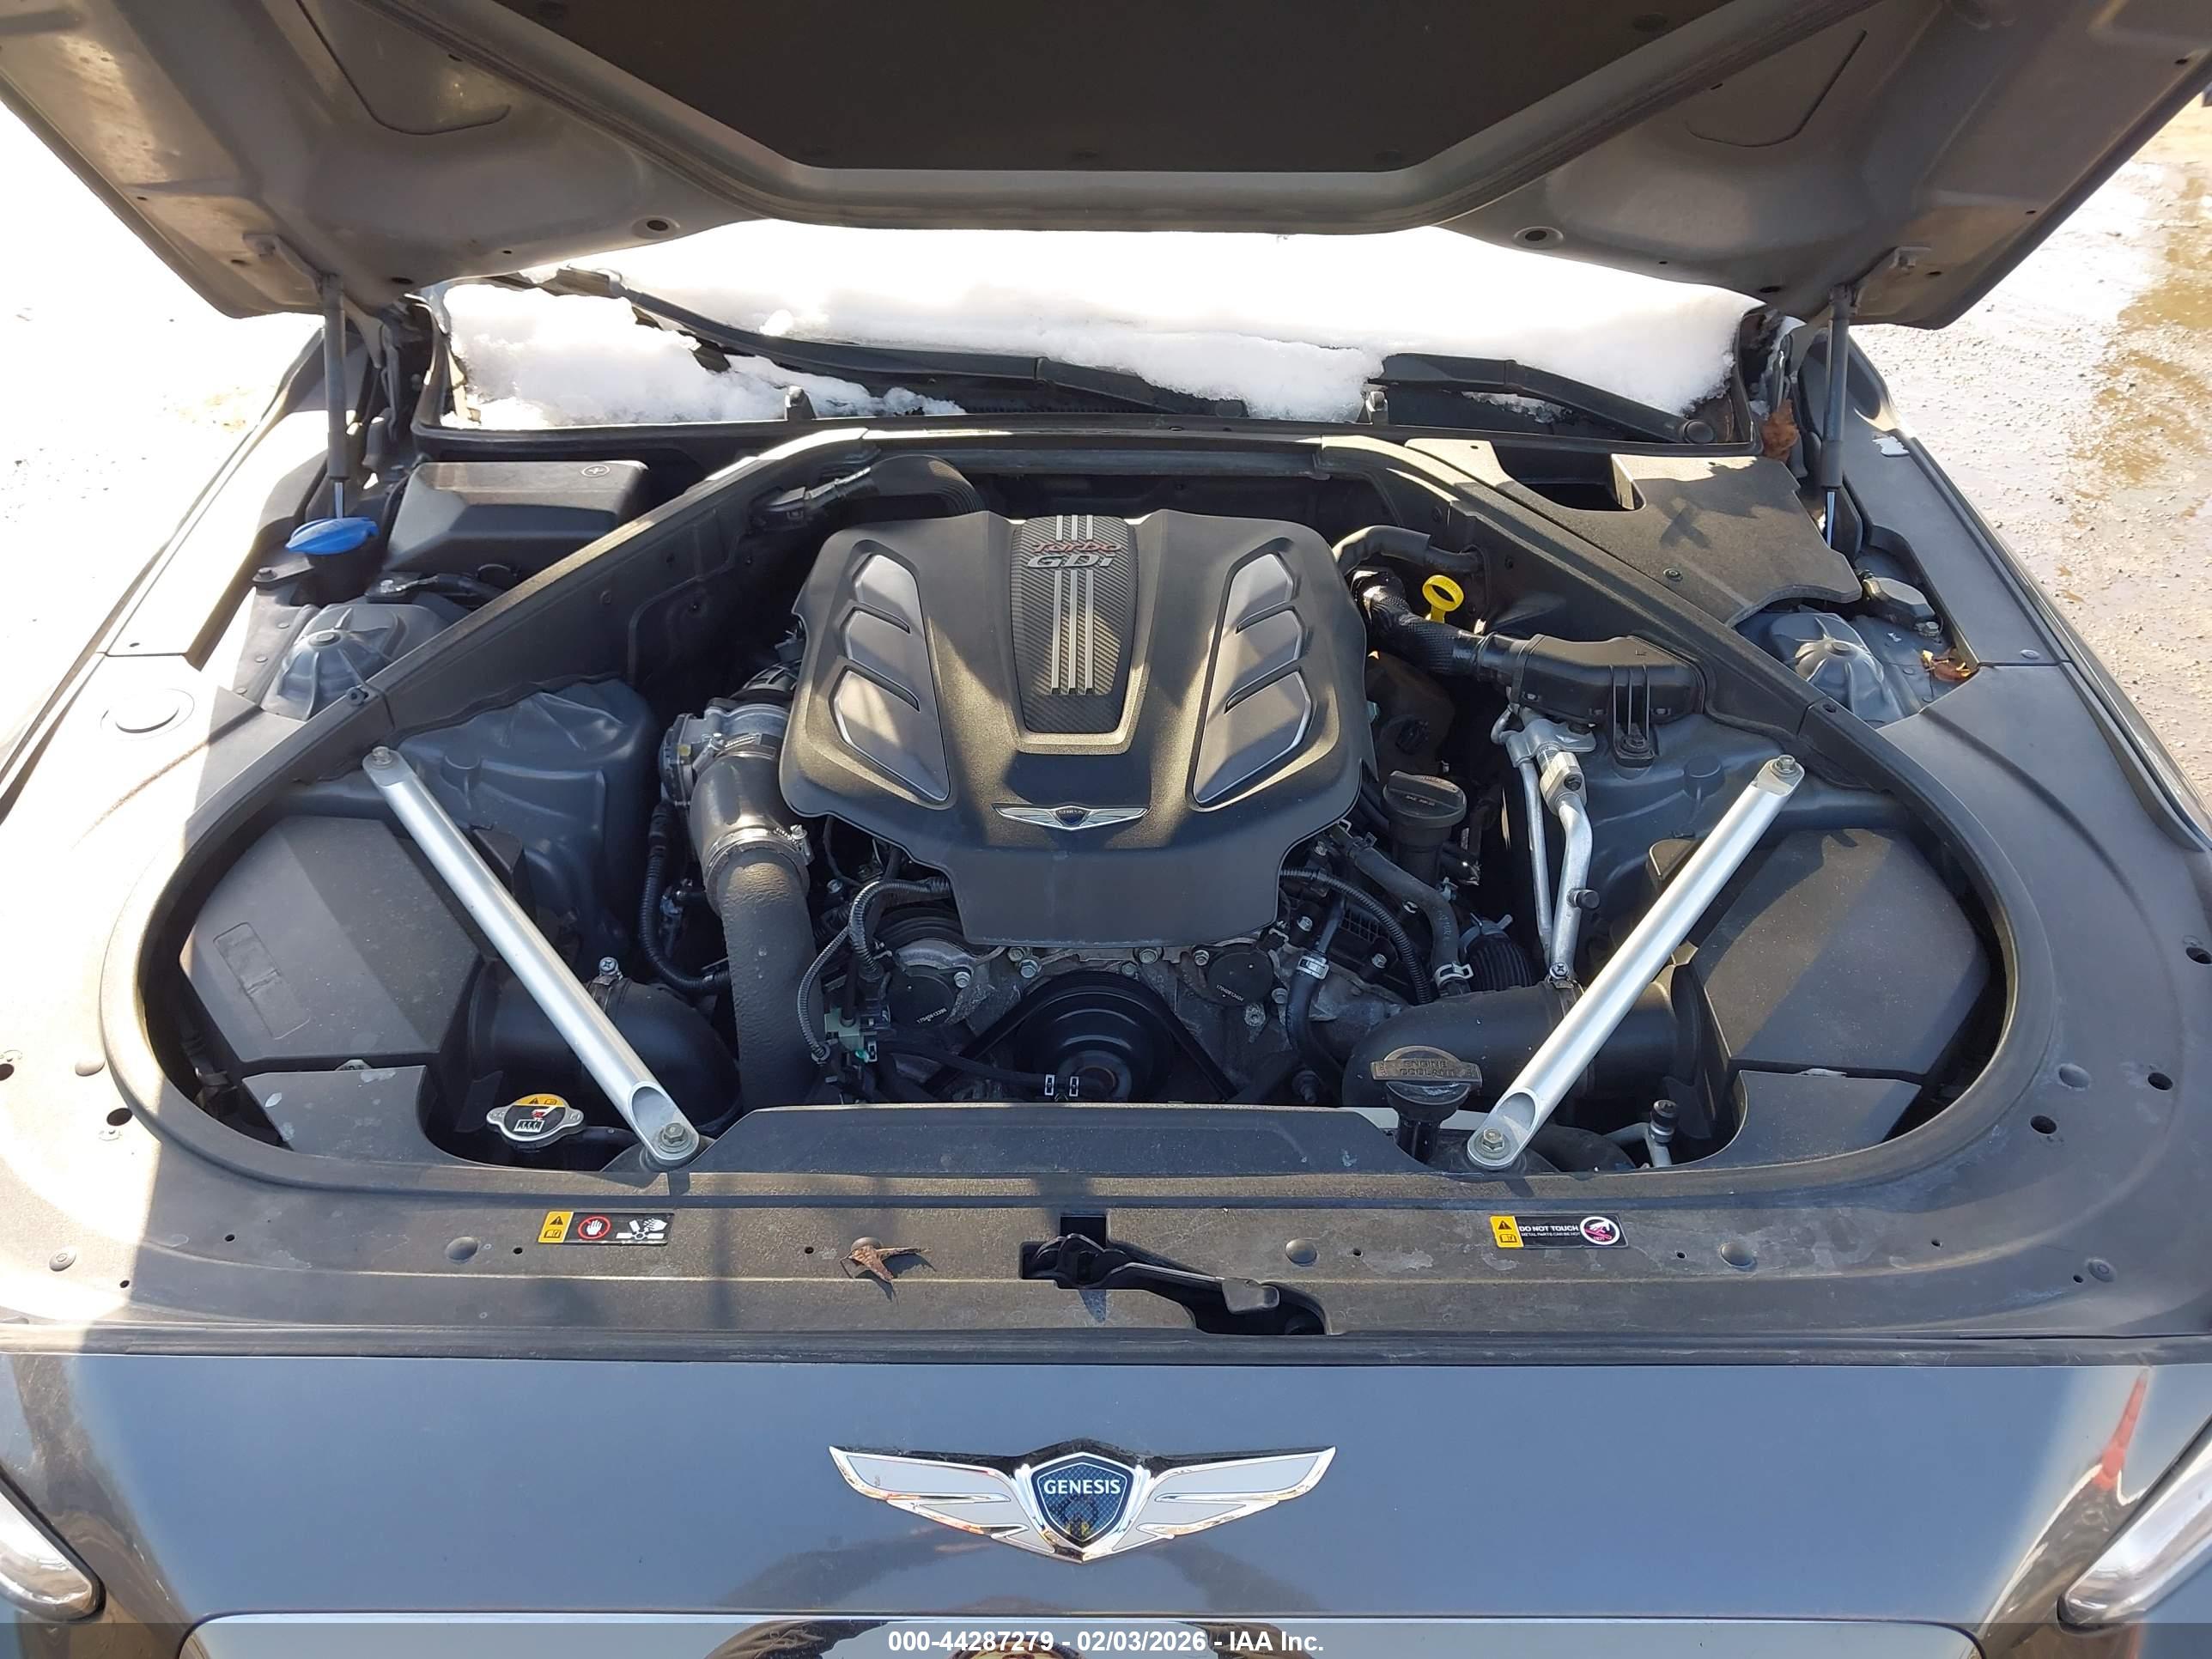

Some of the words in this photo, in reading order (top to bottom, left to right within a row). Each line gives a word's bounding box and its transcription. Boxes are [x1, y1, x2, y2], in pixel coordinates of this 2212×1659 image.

[1403, 1059, 1447, 1068] ENGINE
[1400, 1068, 1454, 1079] COOLANT
[1043, 1479, 1121, 1494] GENESIS
